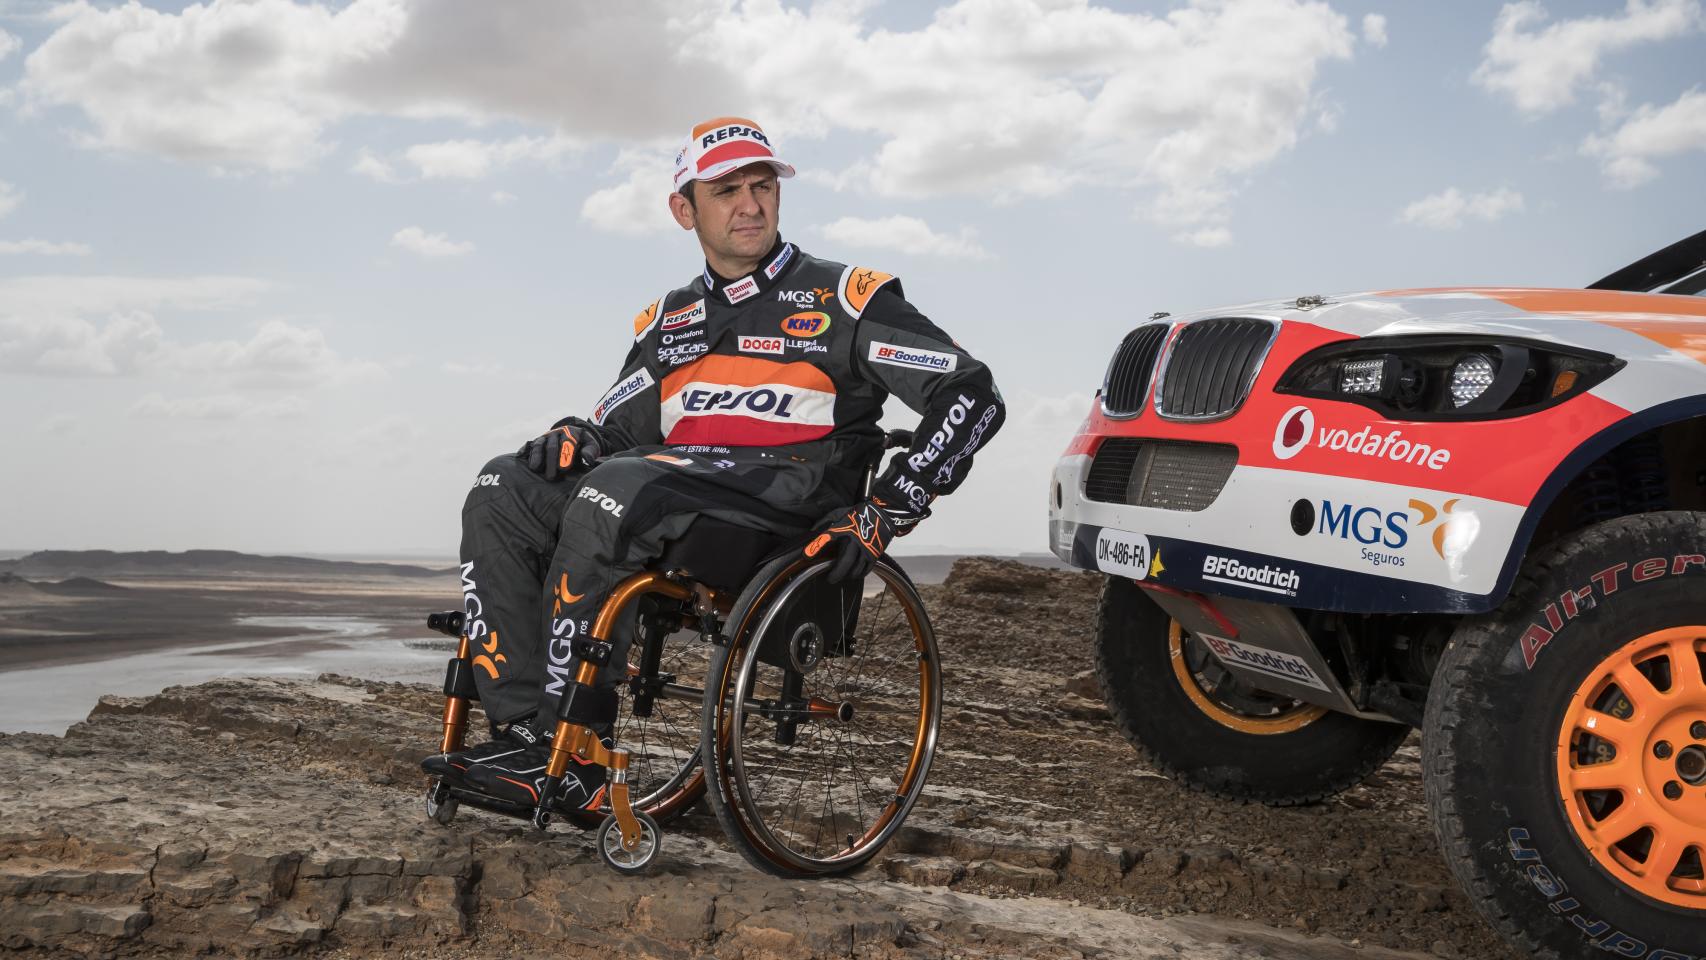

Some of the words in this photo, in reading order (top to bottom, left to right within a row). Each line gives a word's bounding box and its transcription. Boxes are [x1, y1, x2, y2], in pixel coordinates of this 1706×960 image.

[726, 280, 754, 297] Damm
[777, 290, 815, 303] MGS
[665, 306, 704, 324] REPSOL
[674, 329, 704, 341] vodafone
[742, 339, 781, 351] DOGA
[877, 347, 950, 368] BFGoodrich
[594, 375, 645, 421] BFGoodrich
[687, 445, 711, 453] ESTEVE
[907, 393, 976, 473] REPSOL
[1317, 426, 1451, 470] vodafone
[473, 473, 501, 488] SOL
[893, 474, 931, 507] MGS
[576, 486, 625, 518] EPSOL
[1318, 499, 1409, 549] MGS
[1098, 537, 1145, 569] DK-486-FA
[1361, 547, 1405, 567] Seguros
[1202, 555, 1300, 590] BFGoodrich
[460, 559, 488, 641] MGS
[545, 617, 576, 697] MGS
[1205, 636, 1315, 680] BFGoodrich
